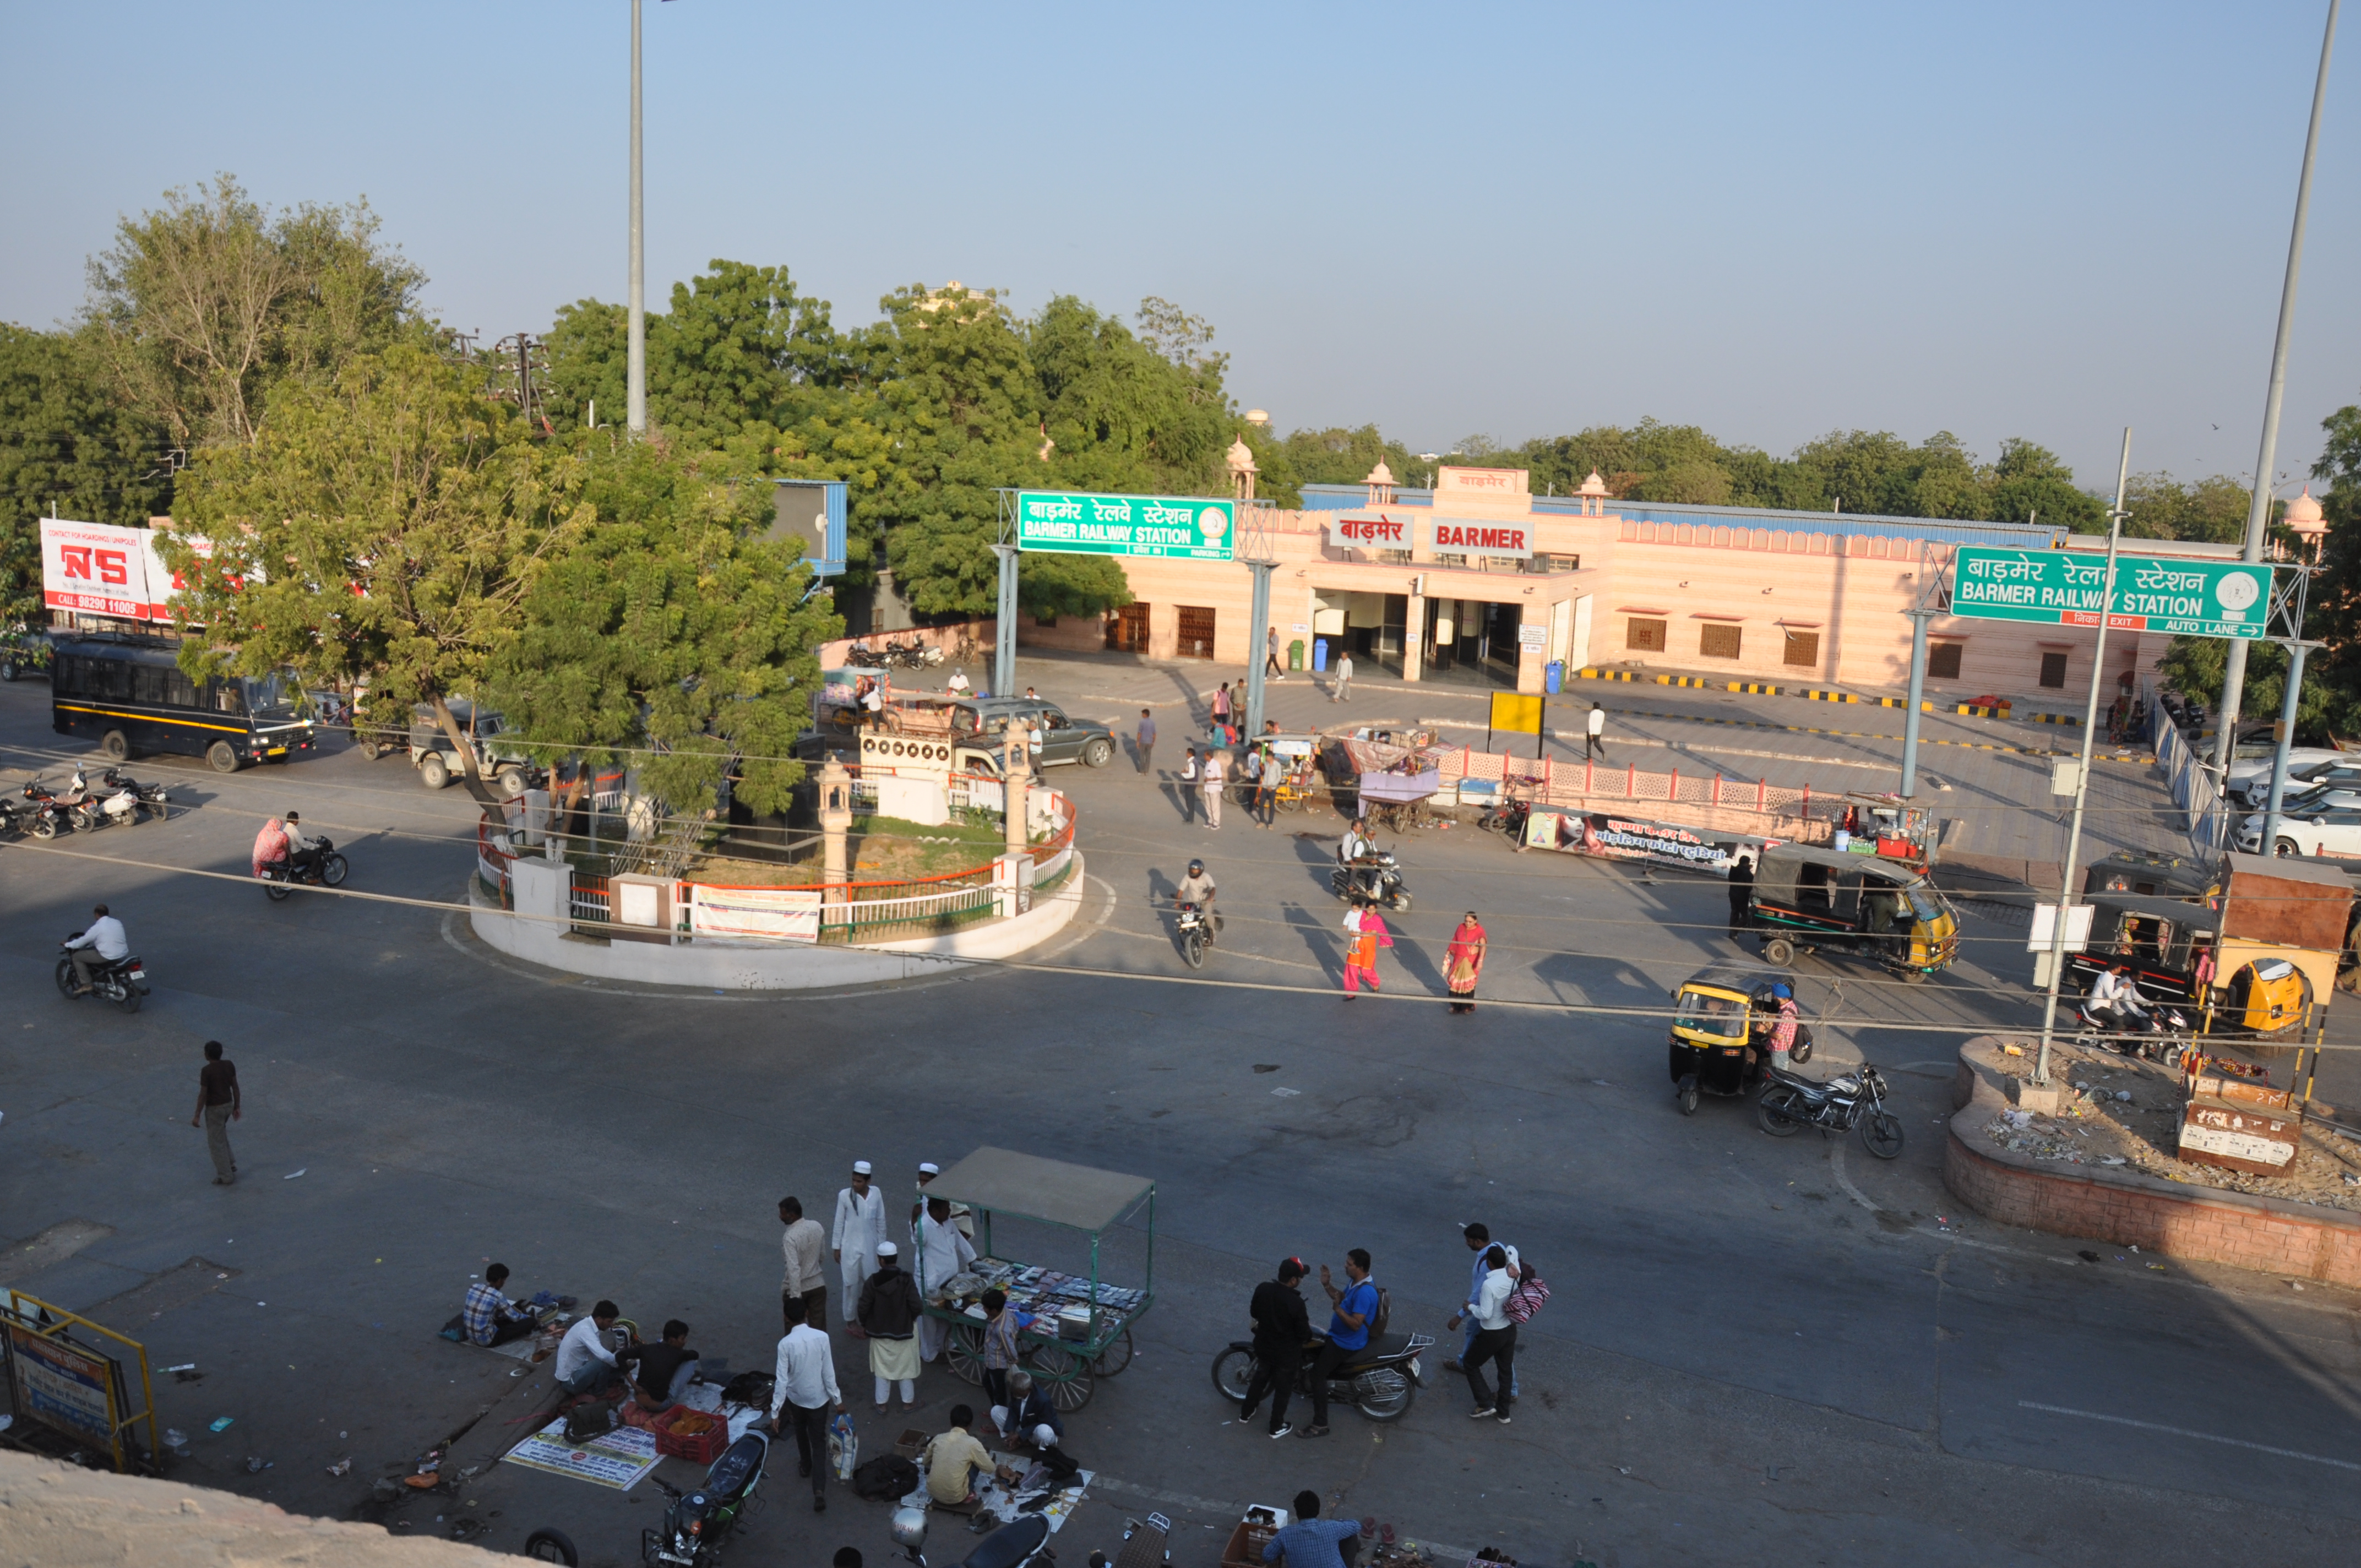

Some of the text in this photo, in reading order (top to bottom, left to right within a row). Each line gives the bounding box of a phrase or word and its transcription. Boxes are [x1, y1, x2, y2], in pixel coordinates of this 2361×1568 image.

[1459, 475, 1506, 487] बाड़मेर
[1027, 496, 1193, 525] बाड़मेर रेलवे स्टेशन
[48, 530, 71, 538] CONTACT
[82, 533, 110, 543] HOARDINGS
[112, 537, 137, 546] UNIPOLES
[1025, 521, 1191, 545] BARMER RAILWAY STATION
[1340, 514, 1403, 544] बाड़मेर
[1437, 526, 1525, 549] BARMER
[1191, 549, 1220, 558] PARKING
[61, 545, 127, 585] NS
[1968, 553, 2047, 583] बाड़मेर
[2135, 562, 2208, 592] स्टेशन
[58, 595, 136, 614] CALL: 98290 11005
[1962, 581, 2036, 604] BARMER
[2124, 593, 2202, 616] STATION
[2110, 617, 2132, 627] EXIT
[2166, 620, 2239, 635] AUTO LANE
[1608, 819, 1644, 834] कृष्णा
[1646, 839, 1679, 854] फोटो
[1679, 845, 1727, 860] स्टुडियो
[63, 1354, 89, 1372] पुलिस
